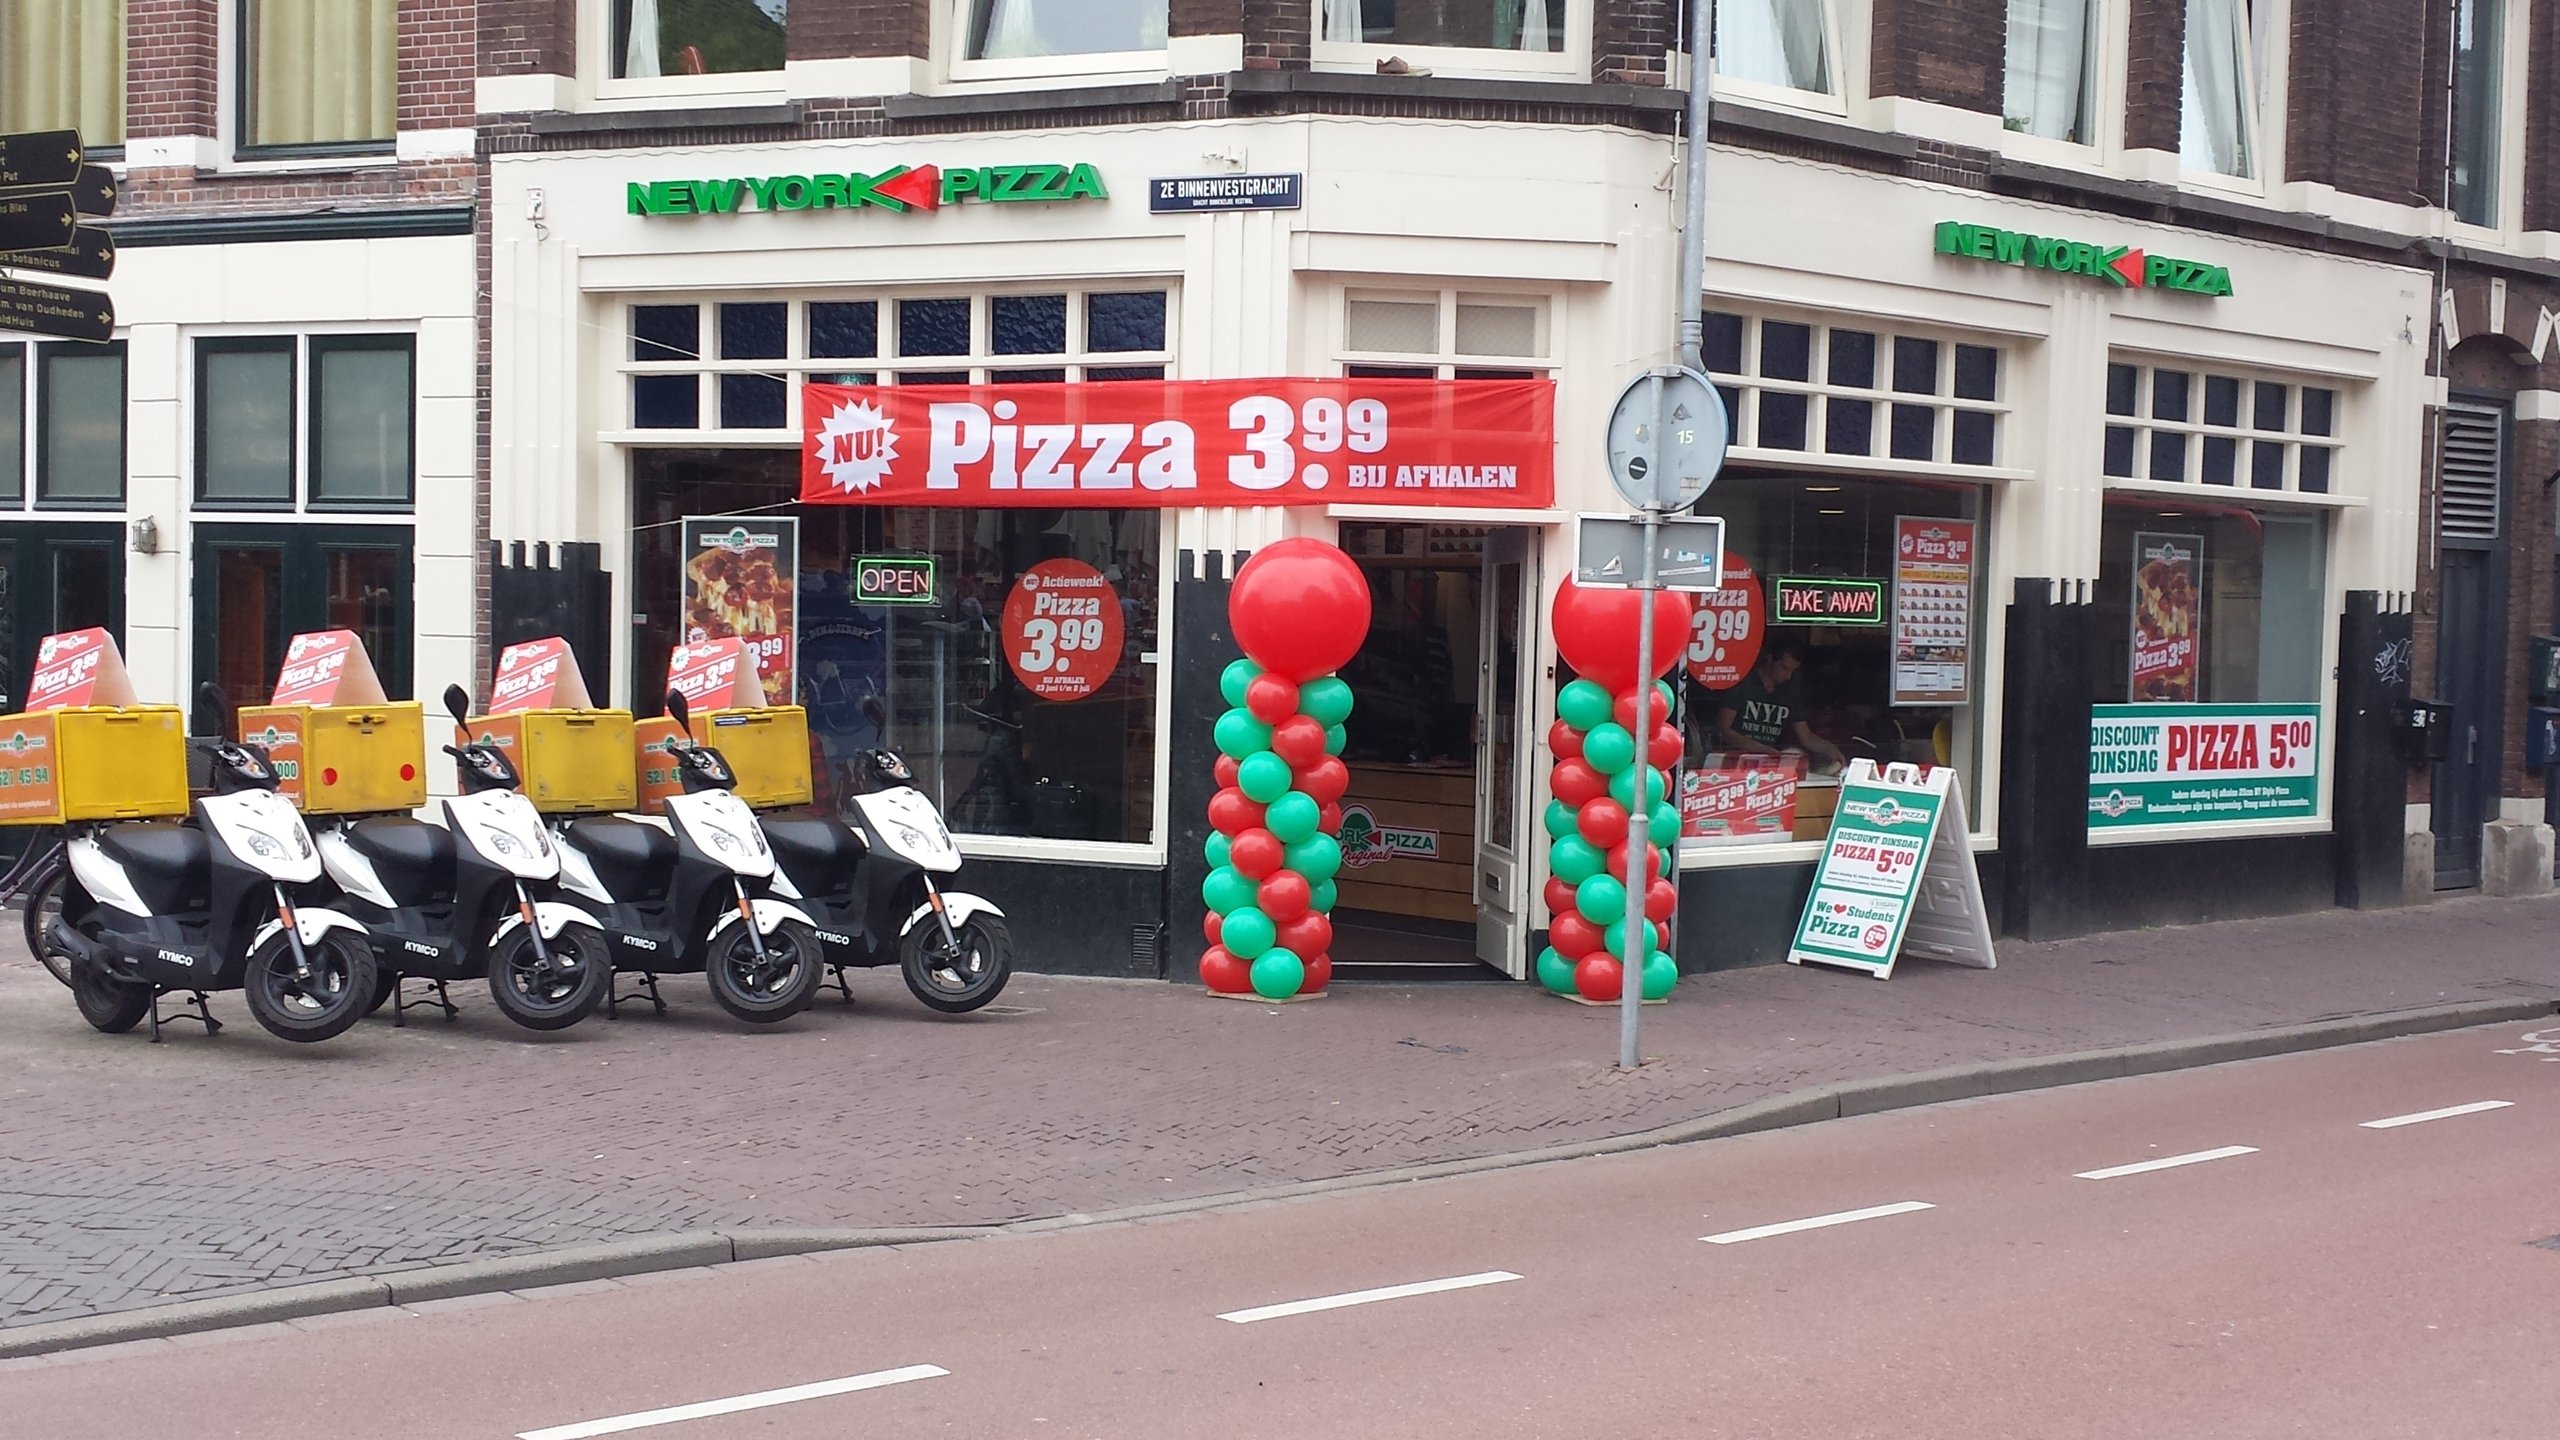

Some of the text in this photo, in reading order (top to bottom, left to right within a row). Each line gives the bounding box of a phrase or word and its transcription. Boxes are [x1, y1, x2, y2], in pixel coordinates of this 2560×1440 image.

[627, 162, 1110, 216] NEW YORK PIZZA
[1160, 177, 1291, 199] 2E BINNENVESTGRACHT
[12, 253, 60, 268] botanicus
[1934, 220, 2234, 297] NEW YORK PIZZA
[19, 285, 71, 302] Boerhaave
[16, 303, 34, 313] van
[36, 303, 85, 319] Oudheden
[831, 427, 887, 465] NU!
[926, 395, 1389, 490] Pizza 3.99
[1677, 430, 1694, 445] 15
[1348, 463, 1518, 490] BIJ AFHALEN
[752, 537, 777, 545] PIZZA
[1917, 538, 1946, 555] Pizza
[861, 568, 930, 593] OPEN
[1042, 575, 1105, 588] Actieweek!
[1034, 592, 1101, 616] Pizza
[1700, 589, 1748, 607] Pizza
[1780, 588, 1877, 613] TAKE AWAY
[1019, 618, 1104, 673] 3.99
[1688, 609, 1750, 663] 3.99
[2134, 639, 2191, 671] Pizza 3.99
[32, 650, 100, 694] Pizza 3.99
[704, 657, 735, 691] 3.99
[1743, 700, 1790, 726] NYP
[1742, 722, 1760, 732] NEW
[2091, 726, 2159, 747] DISCOUNT
[2167, 721, 2312, 771] PIZZA 5.00
[2090, 749, 2159, 774] DINSDAG
[1684, 784, 1745, 812] Pizza 3.99
[1746, 792, 1773, 811] Pizza
[1773, 782, 1796, 808] 3.99
[1846, 804, 1867, 814] NEW
[1901, 810, 1928, 820] PIZZA
[1335, 827, 1434, 851] ORK PIZZA
[1837, 831, 1920, 850] DISCOUNT DINSDAG
[1832, 843, 1915, 874] PIZZA 5.00
[1816, 901, 1833, 914] We
[1847, 905, 1895, 923] Students
[815, 930, 850, 945] KYMCO
[1808, 915, 1860, 939] Pizza
[403, 940, 439, 957] KYMCO
[622, 934, 657, 950] KYMCO
[158, 949, 194, 967] KYMCO
